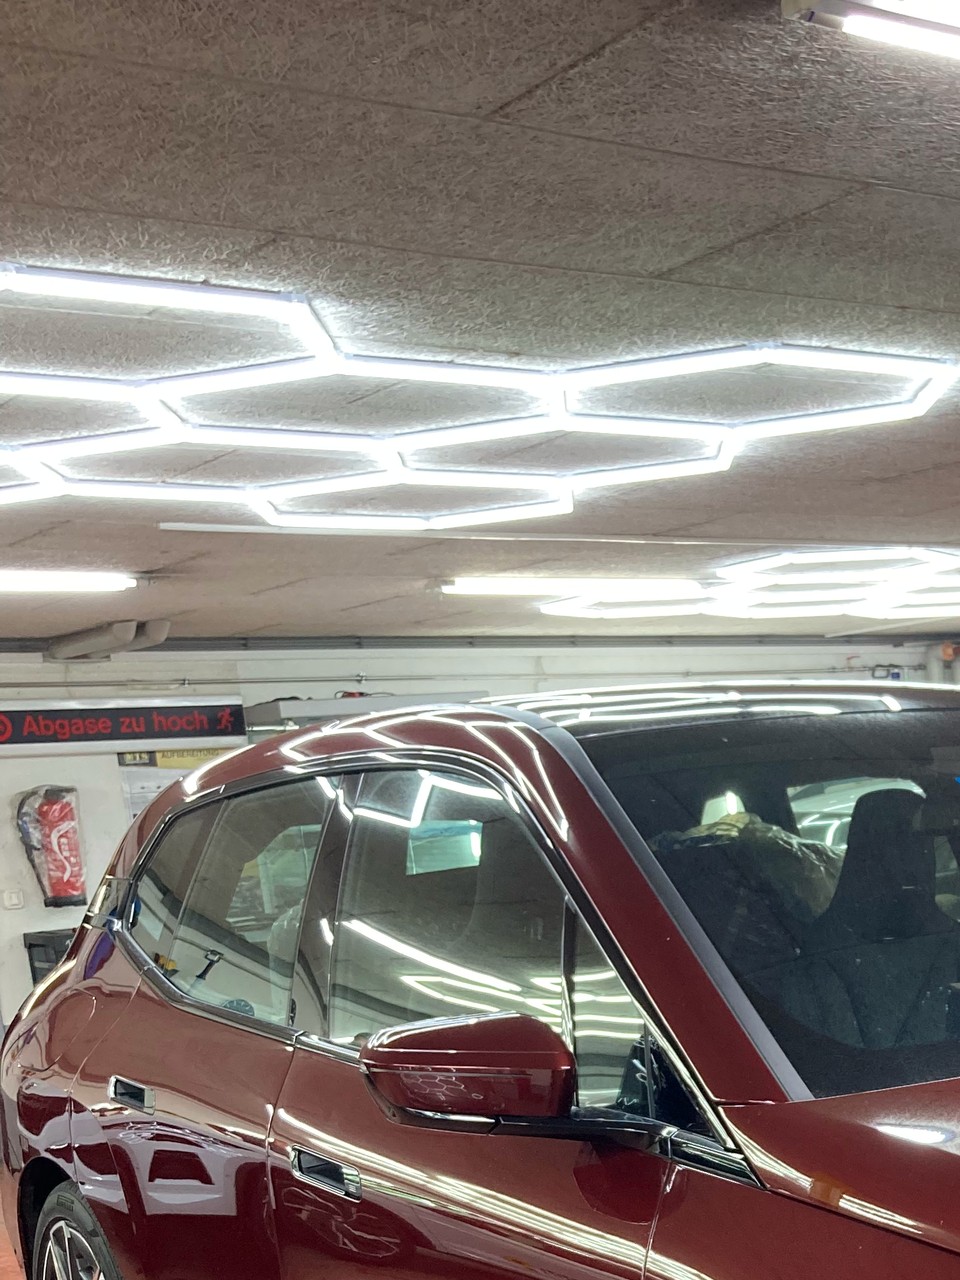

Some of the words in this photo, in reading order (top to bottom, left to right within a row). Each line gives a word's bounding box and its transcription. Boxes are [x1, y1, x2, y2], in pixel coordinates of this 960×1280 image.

[22, 713, 113, 741] Abgase
[120, 716, 146, 734] zu
[151, 709, 209, 733] hoch
